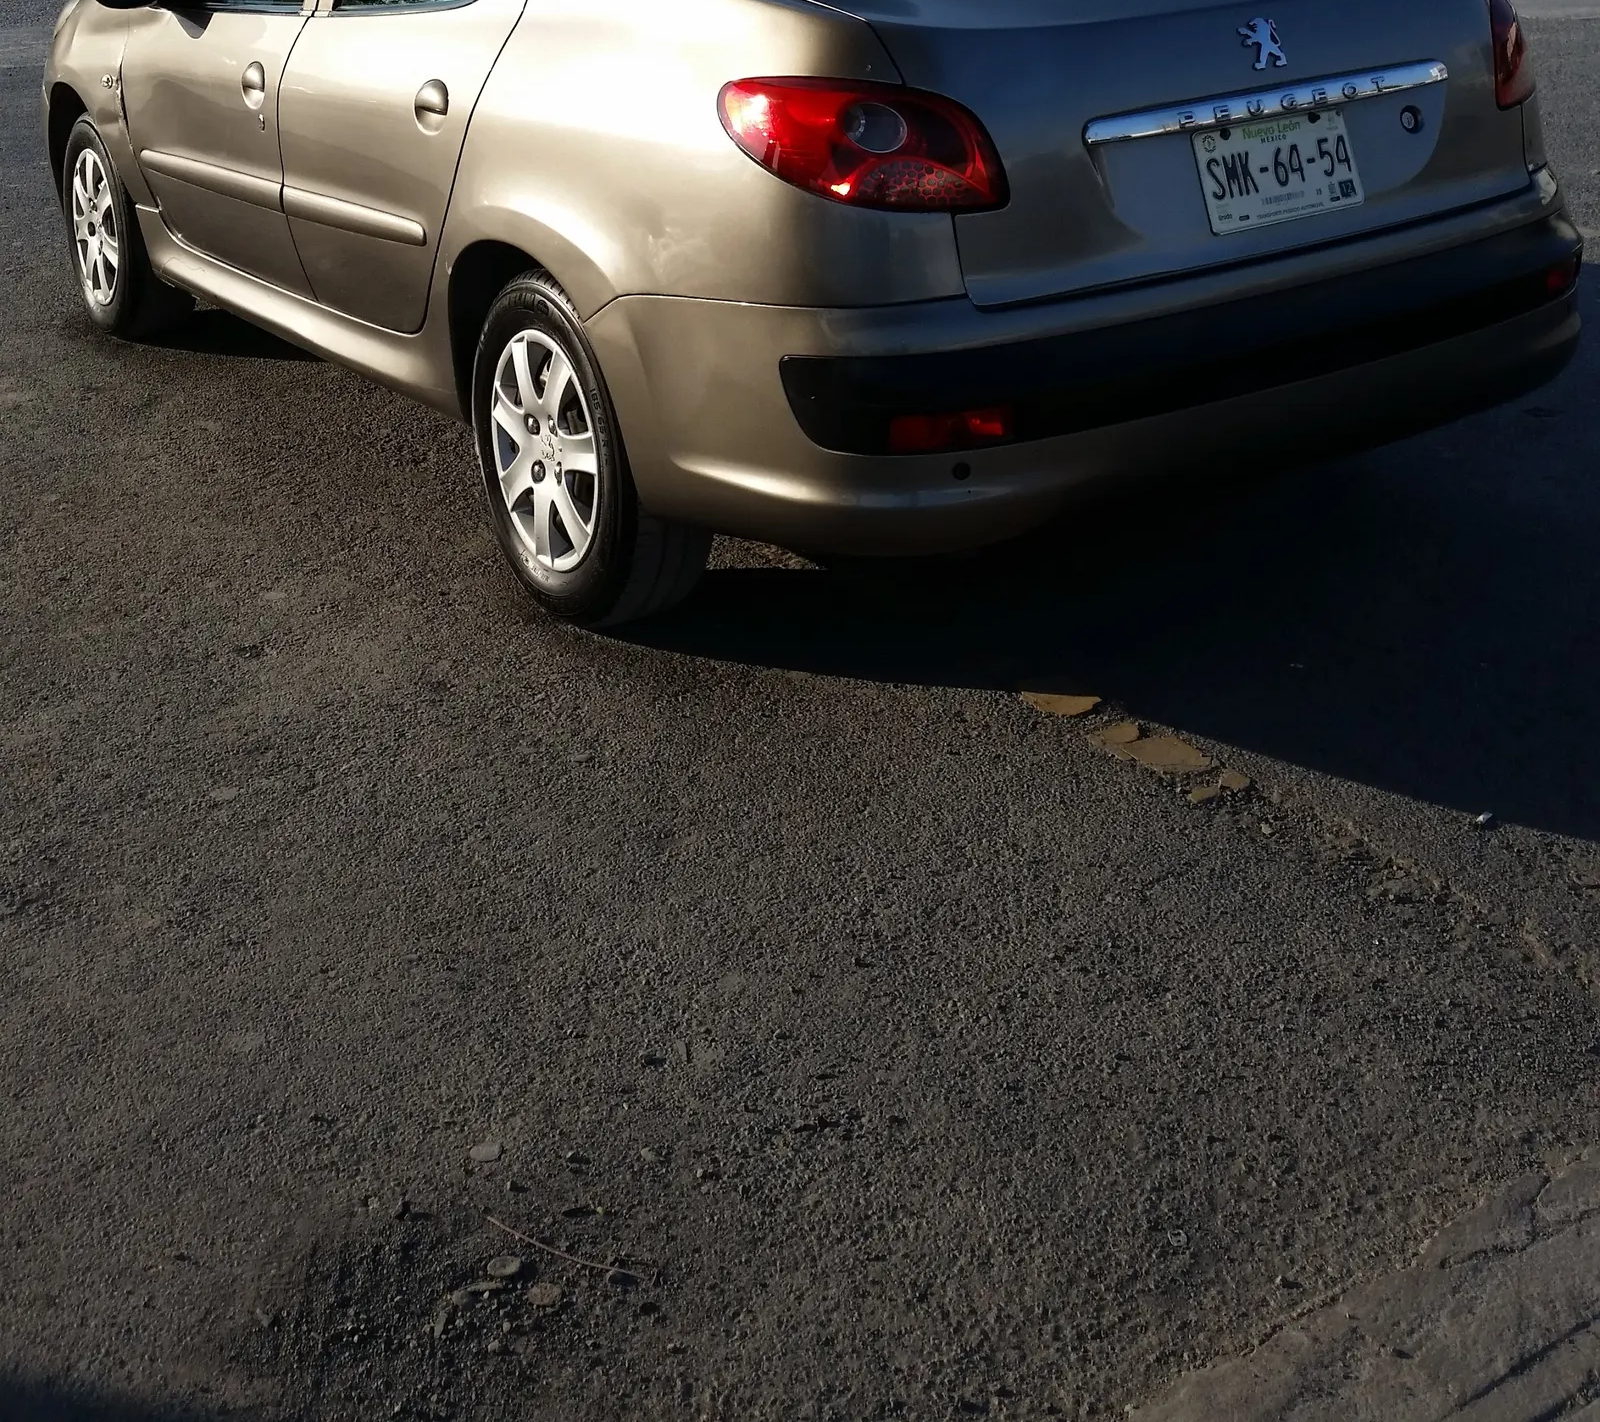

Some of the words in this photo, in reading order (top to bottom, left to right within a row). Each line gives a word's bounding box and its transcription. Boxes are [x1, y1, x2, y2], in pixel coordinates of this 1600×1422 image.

[1178, 75, 1386, 129] PEUGEOT
[1242, 127, 1275, 140] Nuevo
[1277, 120, 1301, 134] León
